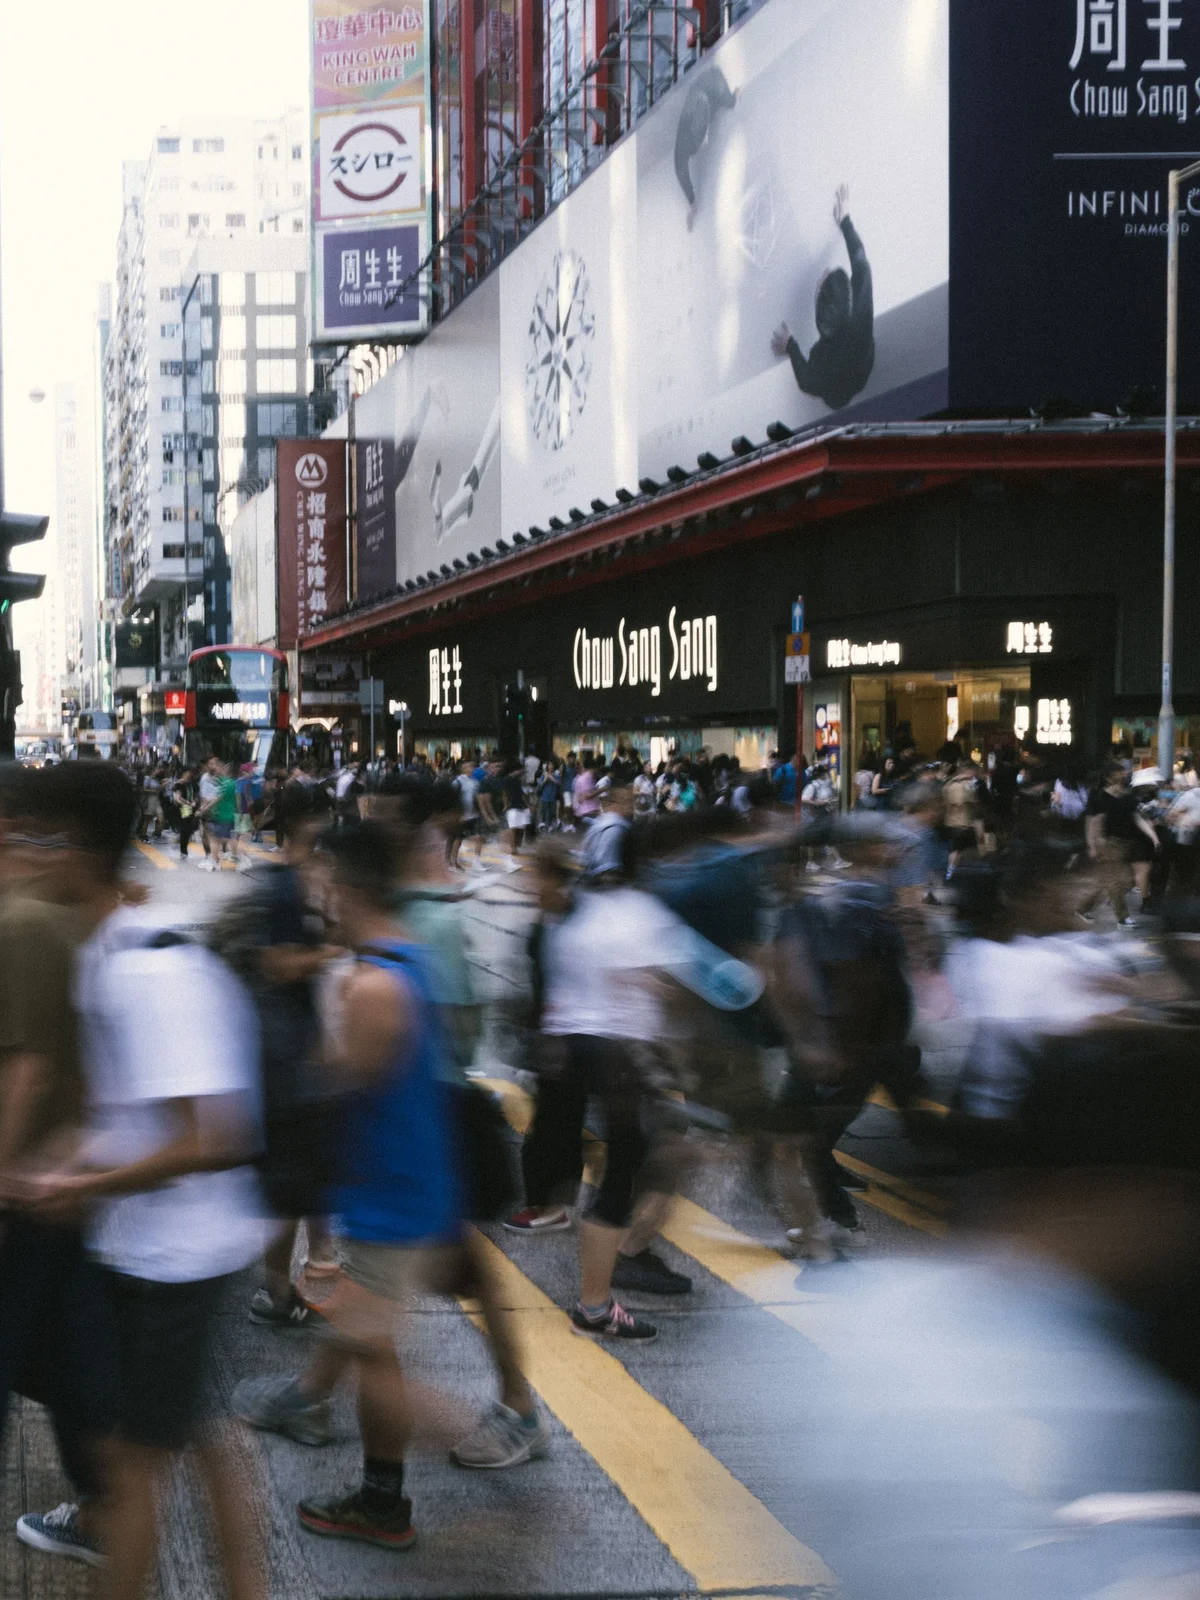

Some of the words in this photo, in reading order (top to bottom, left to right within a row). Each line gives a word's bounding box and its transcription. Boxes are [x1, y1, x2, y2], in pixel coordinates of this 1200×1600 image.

[322, 49, 369, 70] KING
[372, 41, 417, 64] WAH
[334, 63, 404, 87] CENTRE
[1069, 78, 1128, 117] Chow
[1136, 77, 1188, 124] Sang
[326, 152, 413, 176] スシロー
[1068, 190, 1160, 217] INFINI
[1124, 222, 1190, 237] DIAMOD
[339, 245, 404, 291] 周生生
[339, 290, 361, 307] Chow
[574, 627, 614, 690] Chow
[618, 617, 661, 697] Sang
[669, 605, 718, 692] Sang
[428, 644, 463, 715] 周生生
